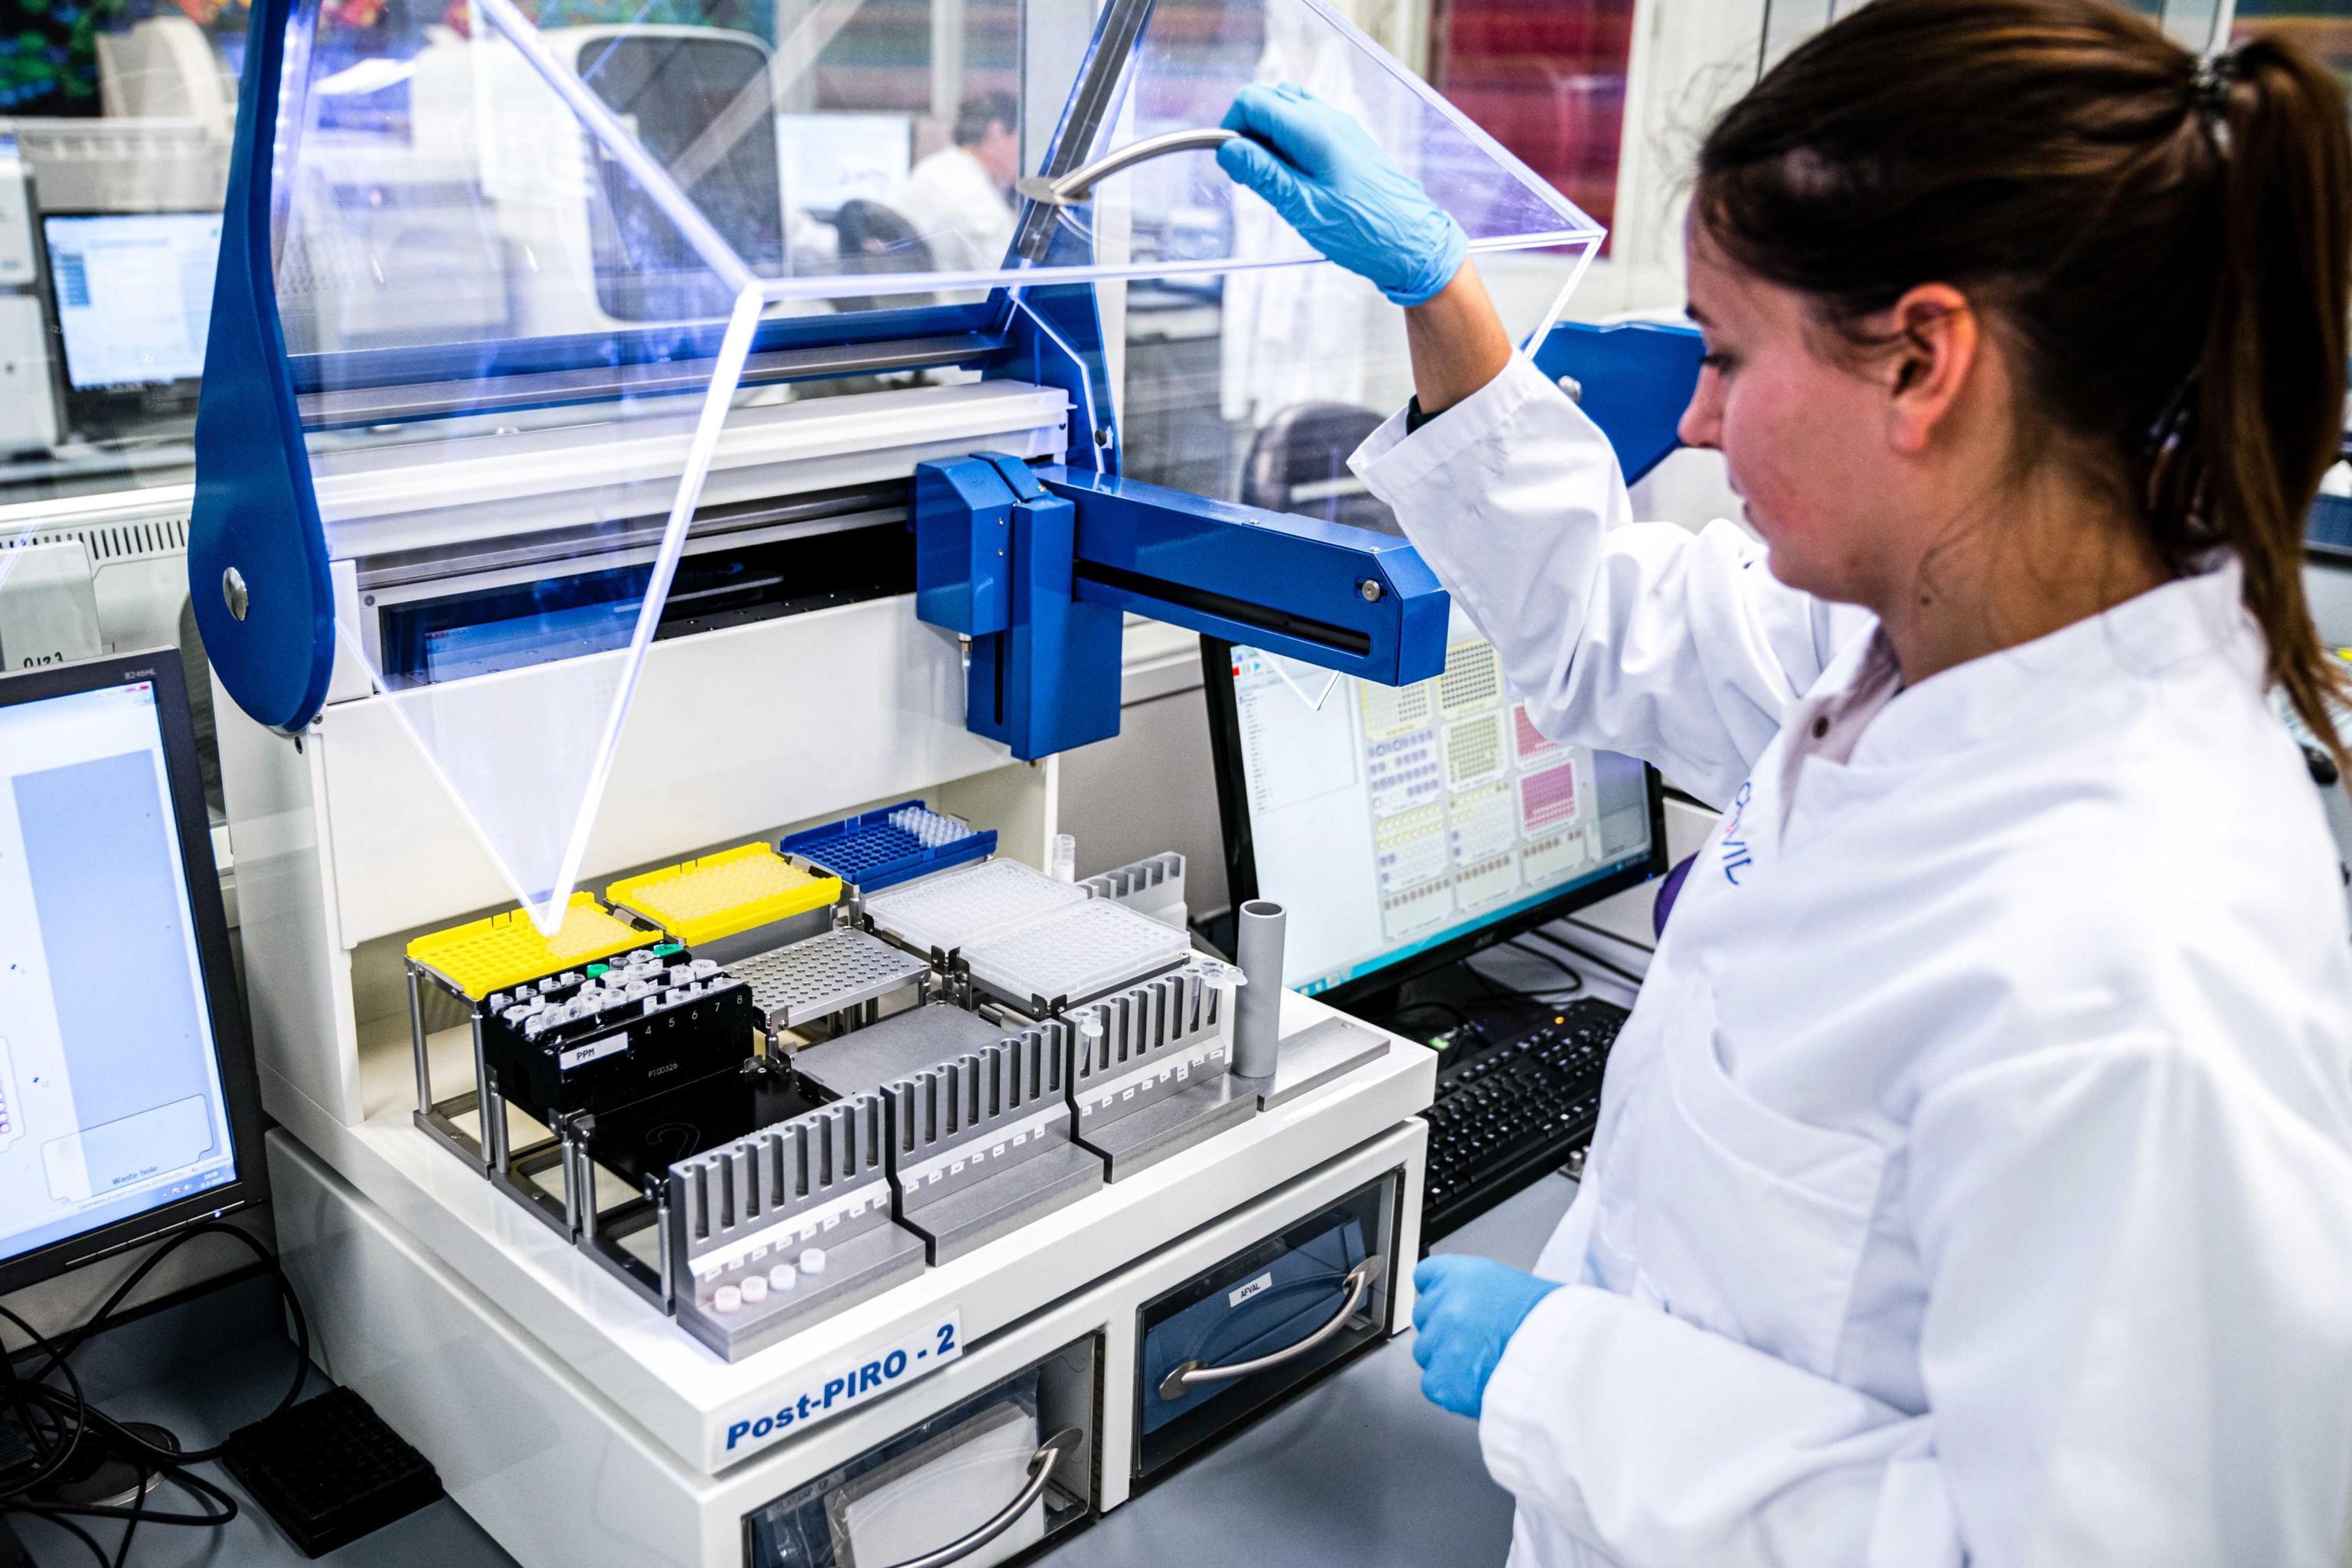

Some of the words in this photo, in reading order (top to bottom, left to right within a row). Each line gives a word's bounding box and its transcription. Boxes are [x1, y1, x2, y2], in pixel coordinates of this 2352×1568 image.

[645, 1025, 652, 1034] 4
[668, 1018, 675, 1027] 5
[691, 1011, 698, 1020] 6
[714, 1002, 720, 1012] 7
[737, 995, 743, 1004] 8
[577, 1047, 595, 1060] PPM
[111, 1173, 138, 1185] Waste
[140, 1166, 158, 1177] hole
[1240, 1282, 1261, 1298] AFVAL
[727, 1349, 907, 1449] Post-PIRO
[936, 1324, 956, 1355] 2
